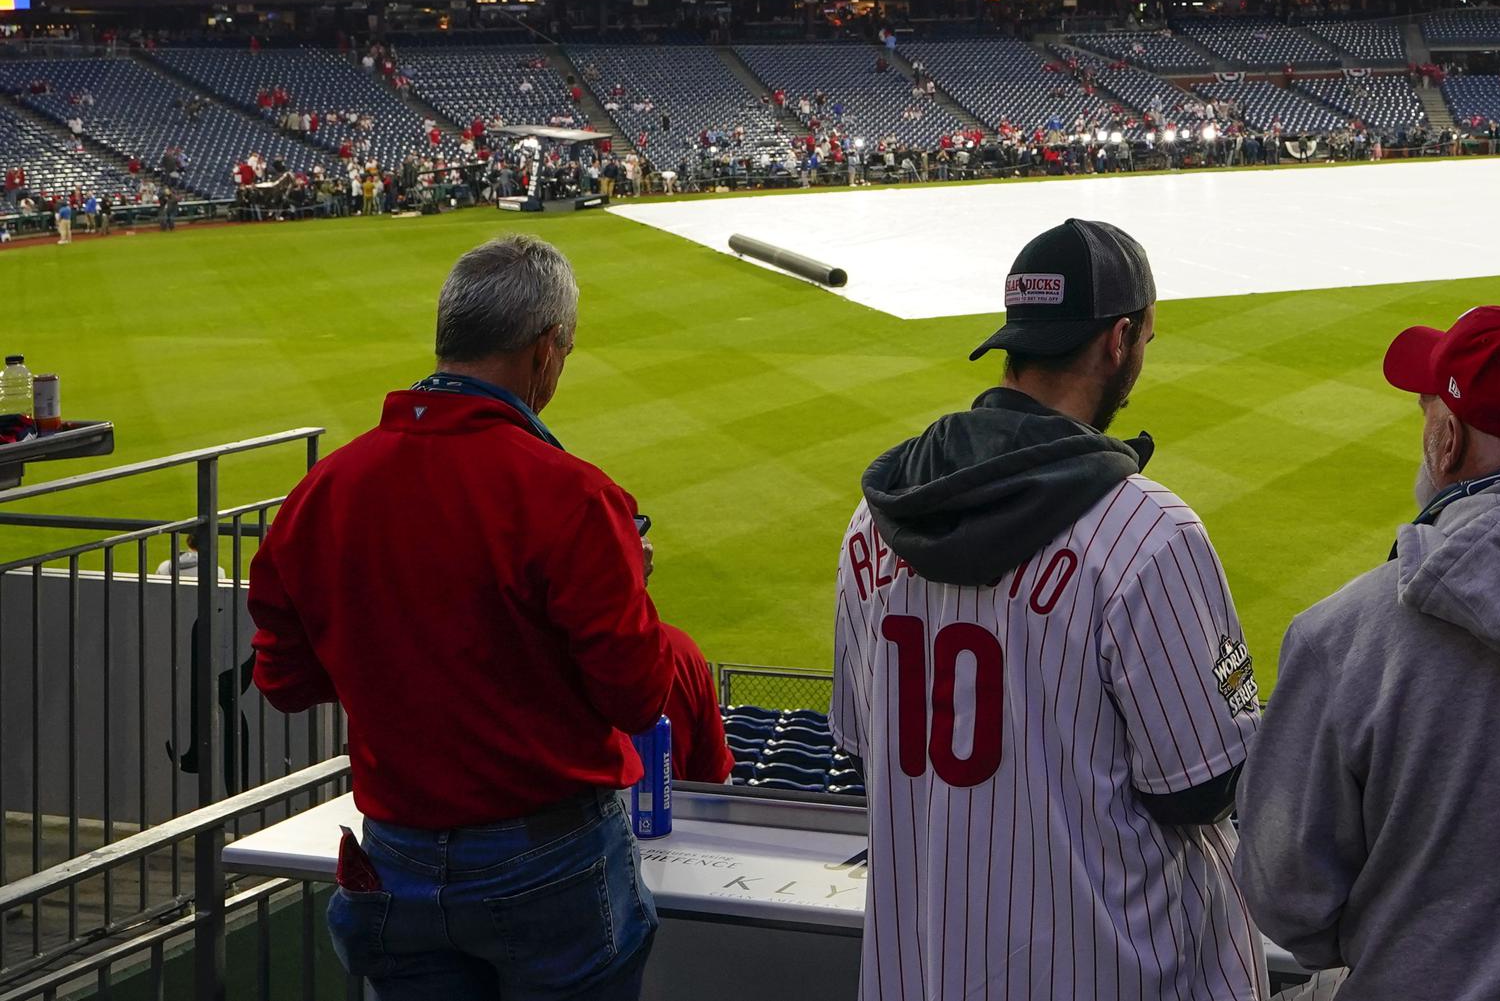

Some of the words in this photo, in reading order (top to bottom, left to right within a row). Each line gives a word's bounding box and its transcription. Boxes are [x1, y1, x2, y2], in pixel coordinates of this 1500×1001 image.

[1025, 278, 1061, 290] DICKS
[1213, 643, 1248, 683] WORLD
[881, 614, 1004, 788] 10
[1229, 676, 1258, 716] SERIES
[663, 752, 671, 785] LIGHT
[663, 786, 671, 810] BUD
